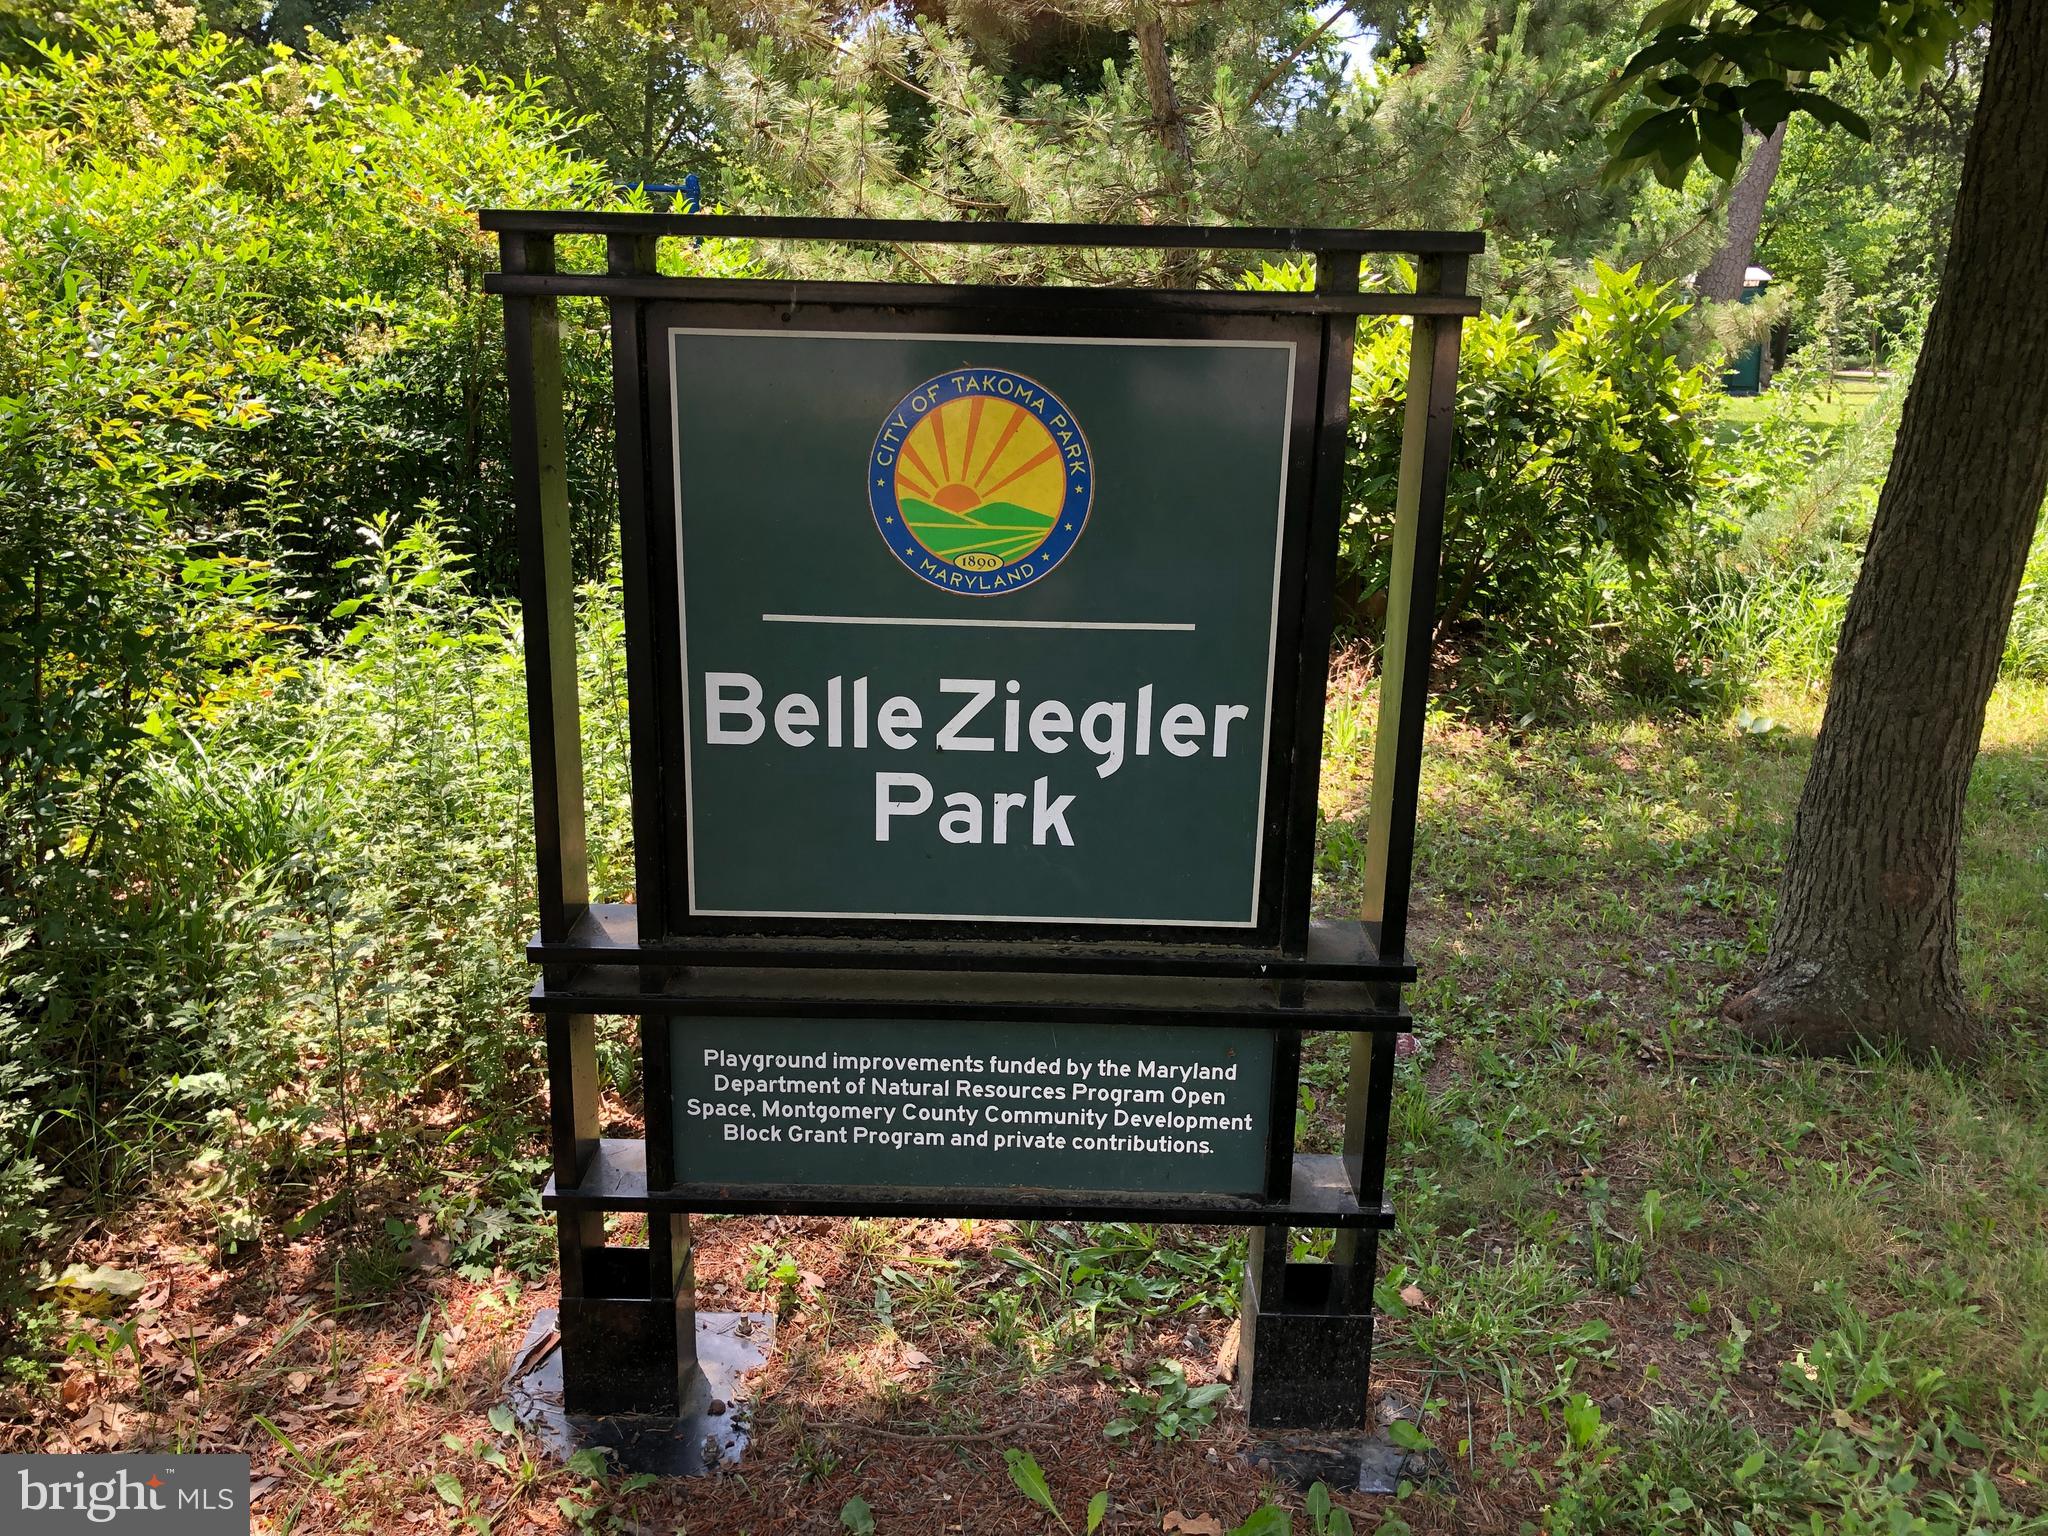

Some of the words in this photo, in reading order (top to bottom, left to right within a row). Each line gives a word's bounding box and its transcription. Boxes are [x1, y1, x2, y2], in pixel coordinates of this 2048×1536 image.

[877, 413, 908, 466] CITY
[911, 384, 939, 413] OF
[951, 375, 1046, 414] TAKOMA
[1049, 413, 1086, 476] PARK
[920, 559, 1034, 590] MARYLAND
[962, 556, 997, 570] 1890
[704, 672, 923, 750] Belle
[936, 678, 1250, 779] Ziegler
[874, 771, 1078, 847] Park
[704, 1050, 827, 1072] Playground
[833, 1052, 985, 1073] improvements
[989, 1056, 1061, 1074] funded
[1066, 1059, 1093, 1079] by
[1097, 1059, 1132, 1077] the
[1137, 1061, 1237, 1083] Maryland
[714, 1075, 841, 1096] Department
[845, 1076, 866, 1094] of
[871, 1078, 950, 1096] Natural
[956, 1080, 1066, 1099] Resources
[1072, 1083, 1165, 1107] Program
[1171, 1087, 1226, 1108] Open
[686, 1099, 756, 1119] Space,
[762, 1100, 897, 1123] Montgomery
[902, 1104, 979, 1126] County
[984, 1106, 1109, 1129] Community
[1113, 1110, 1253, 1132] Development
[723, 1124, 782, 1141] Block
[788, 1125, 848, 1143] Grant
[853, 1127, 945, 1149] Program
[950, 1130, 988, 1147] and
[993, 1131, 1067, 1151] private
[1071, 1134, 1214, 1154] contributions.
